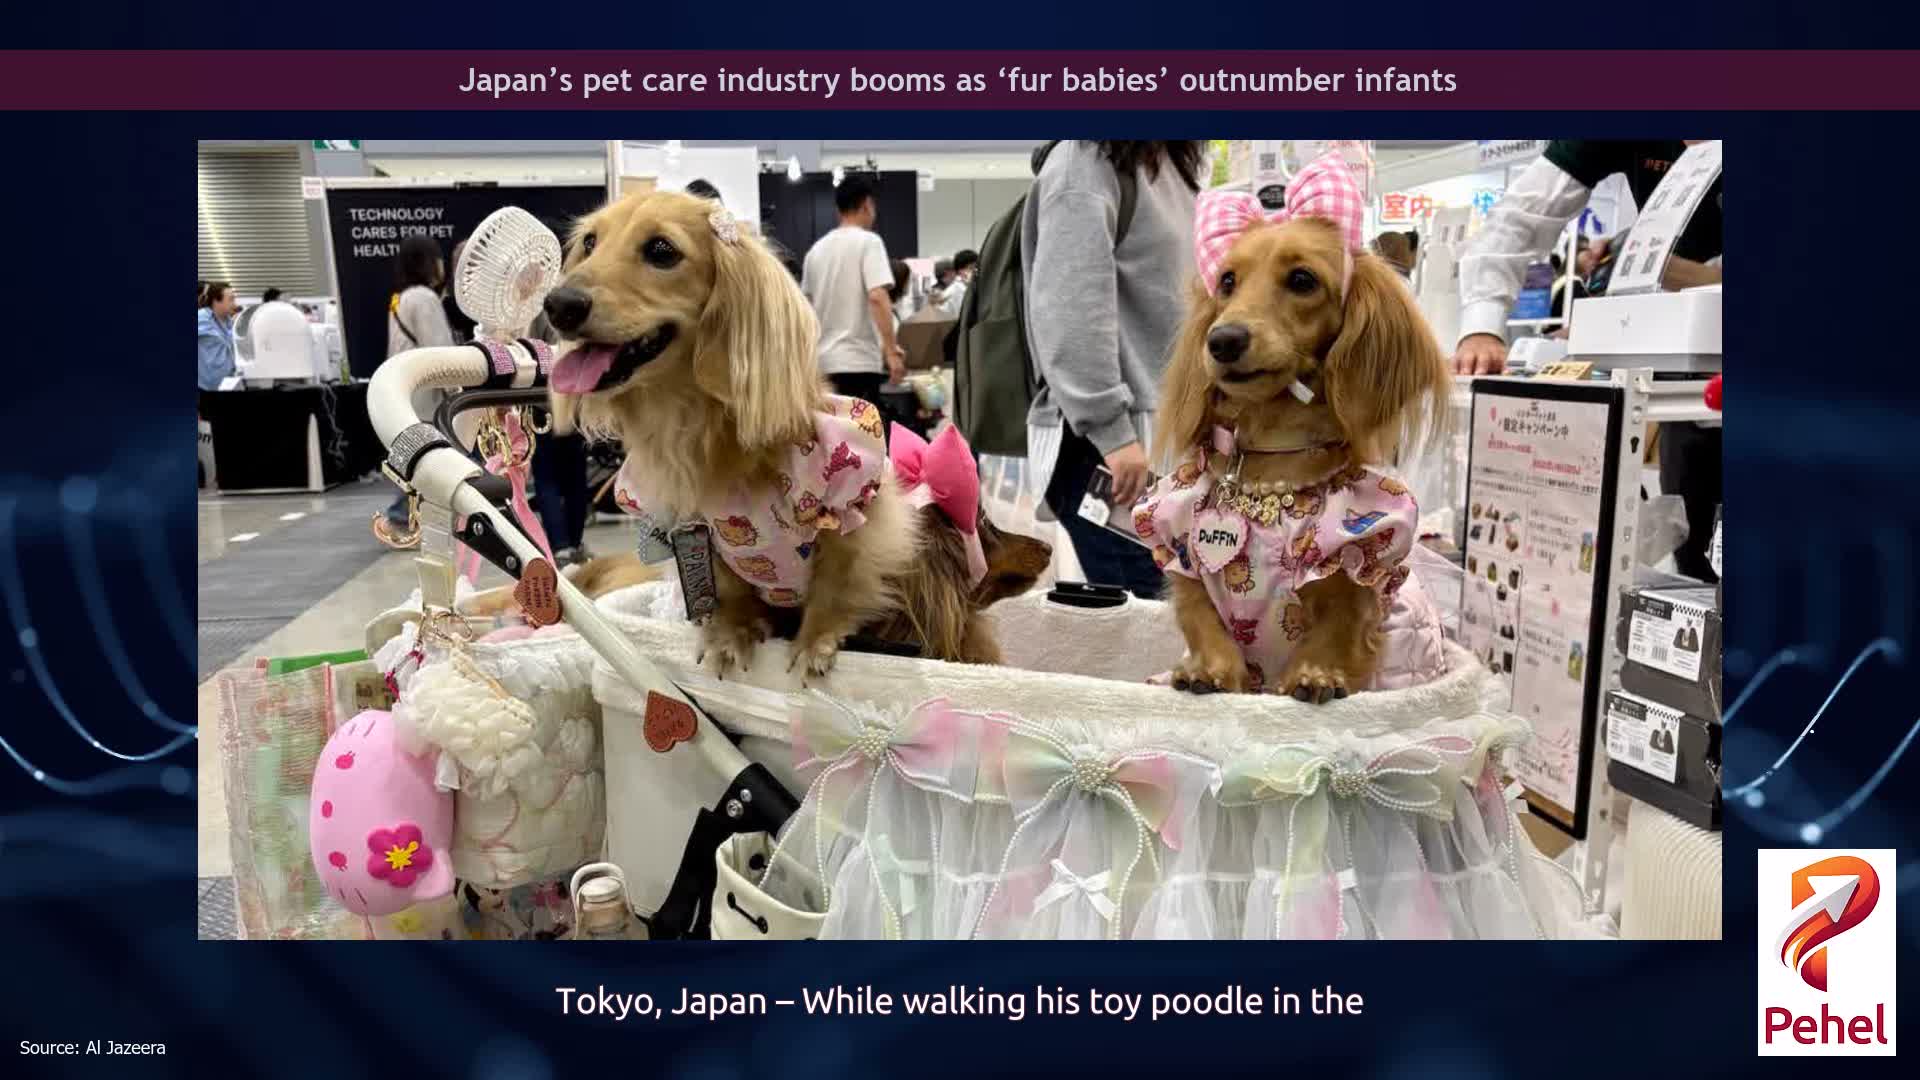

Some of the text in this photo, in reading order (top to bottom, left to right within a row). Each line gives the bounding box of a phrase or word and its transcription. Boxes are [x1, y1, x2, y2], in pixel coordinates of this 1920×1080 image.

[350, 207, 444, 221] TECHNOLOGY
[351, 224, 455, 239] CARES FOR PET
[650, 527, 673, 549] PA
